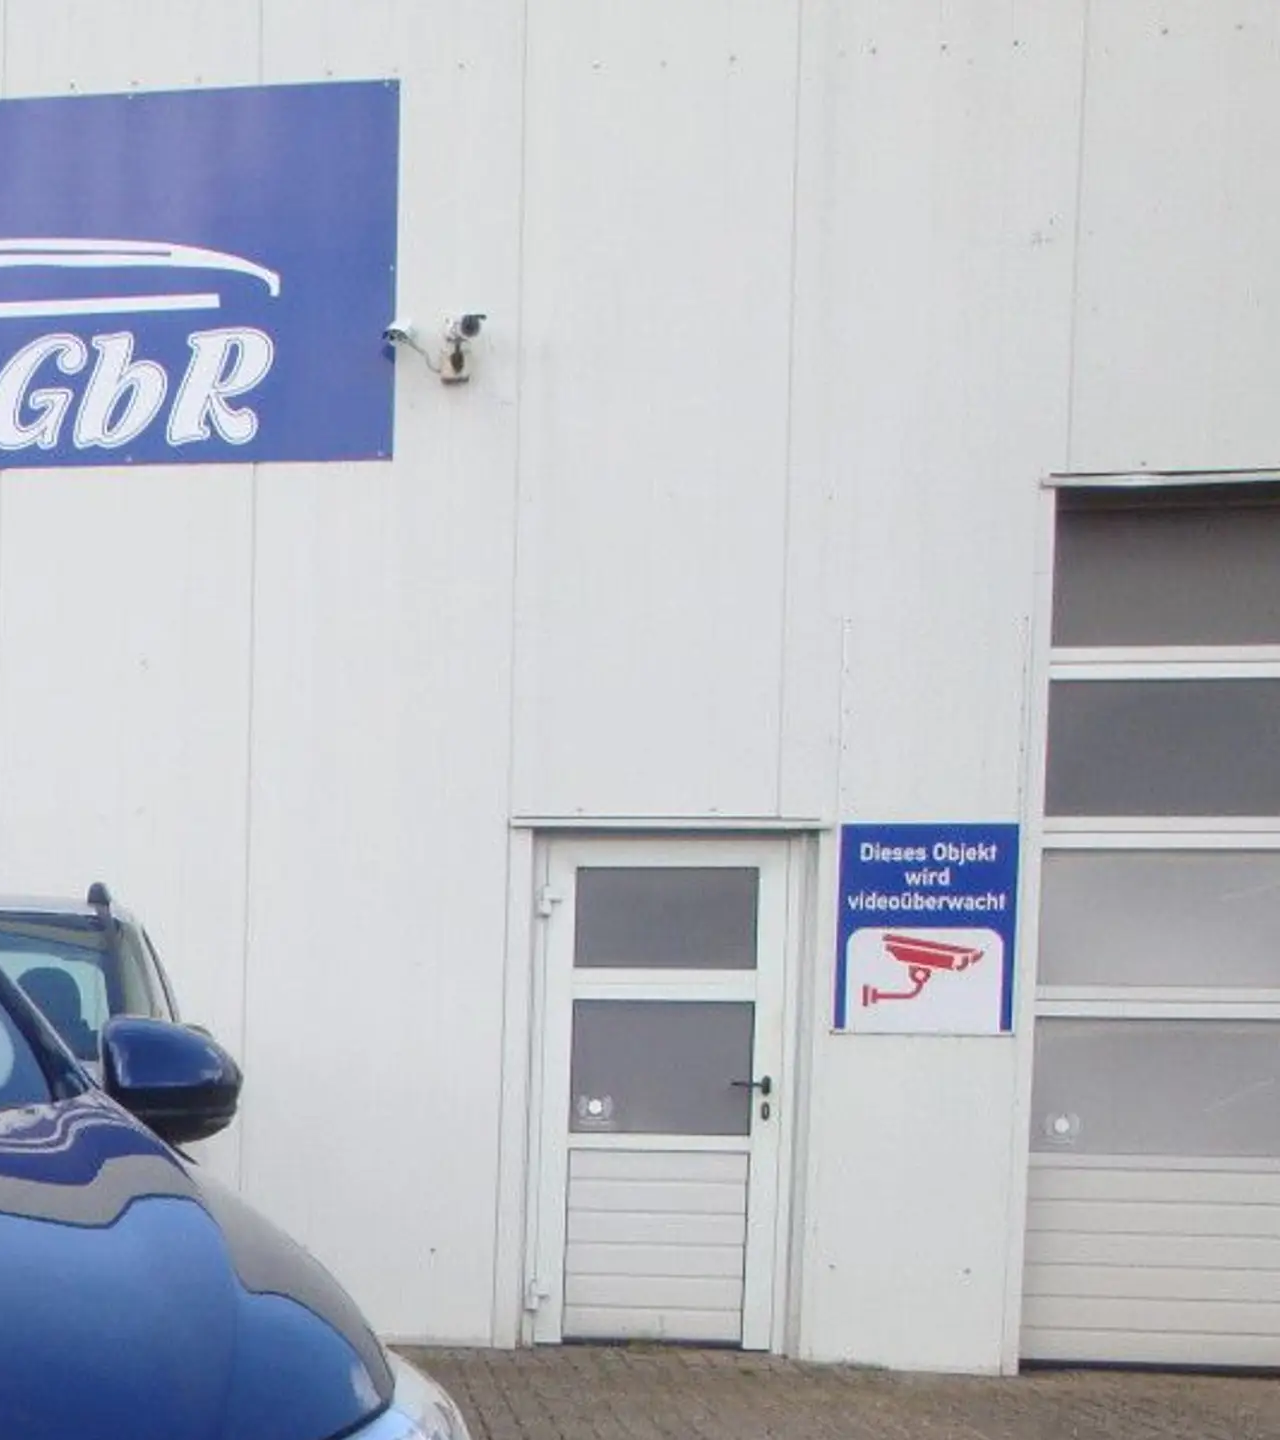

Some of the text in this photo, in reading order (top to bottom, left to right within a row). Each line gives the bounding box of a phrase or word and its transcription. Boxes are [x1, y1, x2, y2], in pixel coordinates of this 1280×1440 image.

[859, 841, 998, 866] Dieses Objekt
[905, 867, 951, 886] wird
[847, 891, 1006, 911] videoüberwacht
